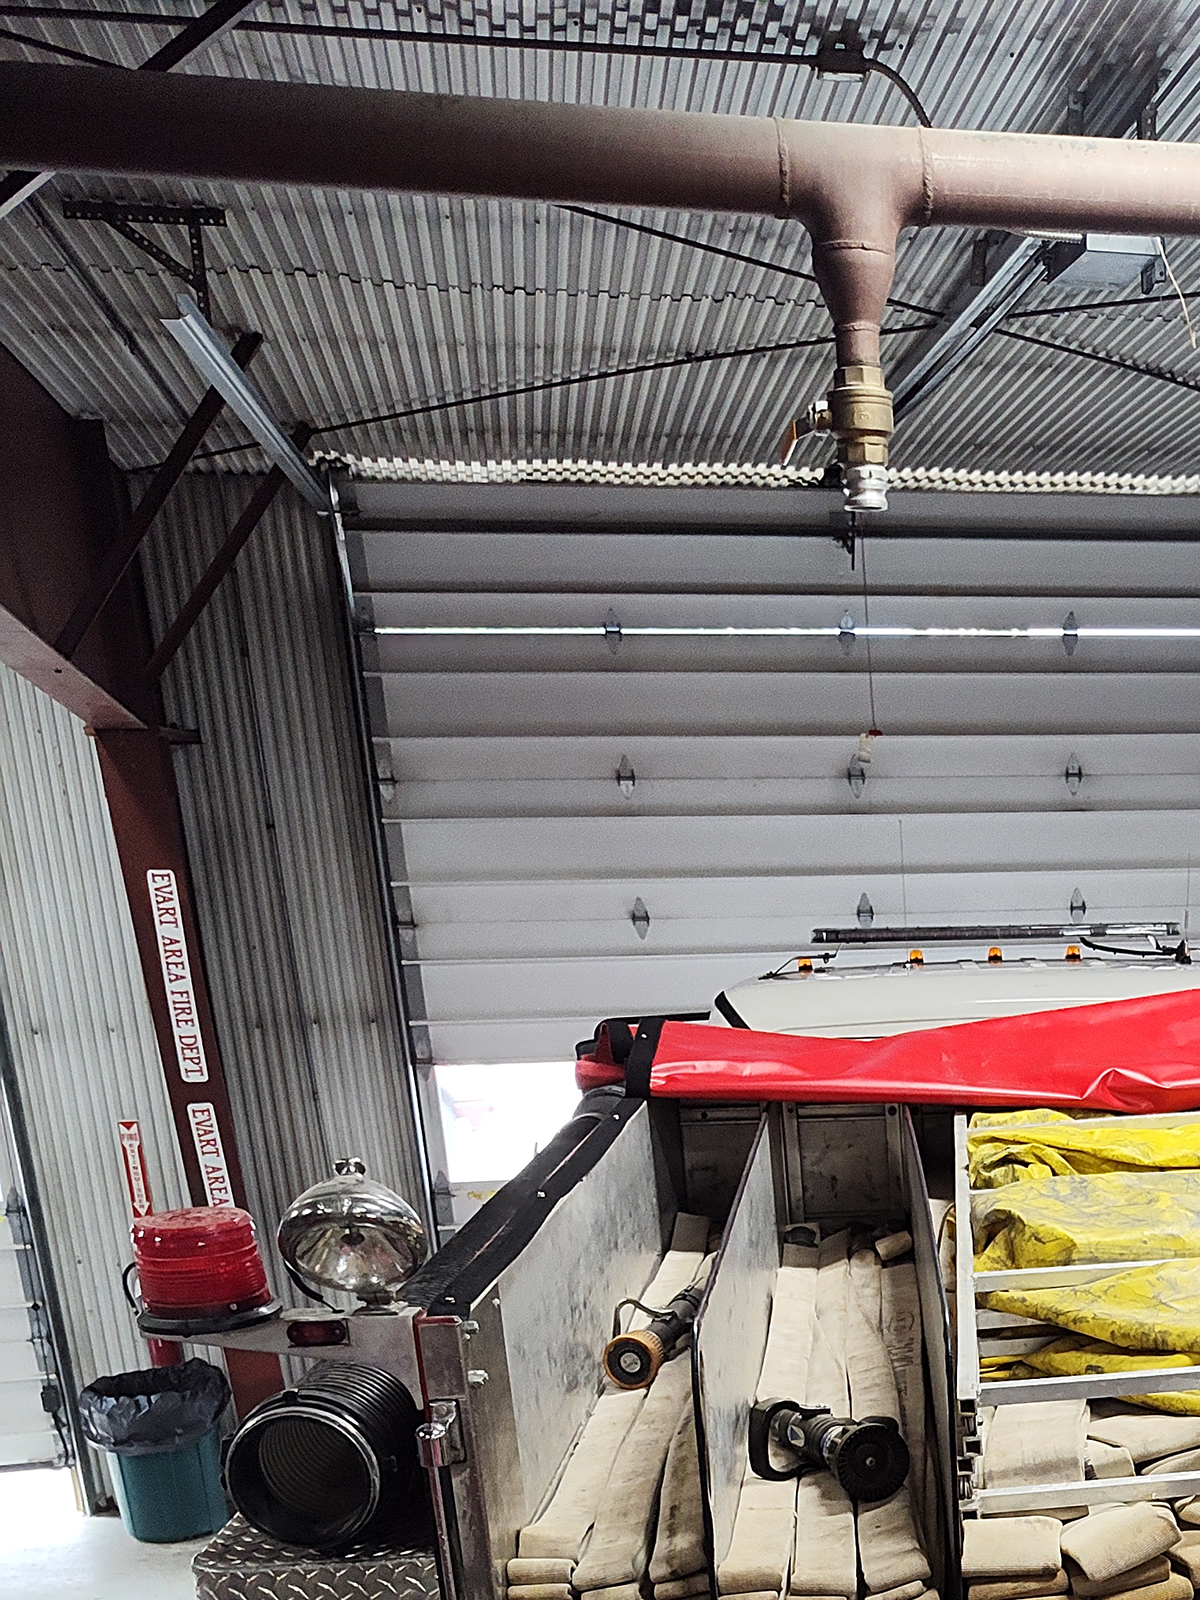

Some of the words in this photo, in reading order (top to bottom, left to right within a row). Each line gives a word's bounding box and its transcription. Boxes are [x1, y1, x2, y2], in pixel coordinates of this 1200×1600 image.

[151, 873, 179, 928] EVART
[162, 935, 187, 984] AREA
[171, 990, 194, 1028] FIRE
[179, 1034, 204, 1078] DEPT
[192, 1108, 220, 1157] EVART
[204, 1164, 230, 1207] AREA
